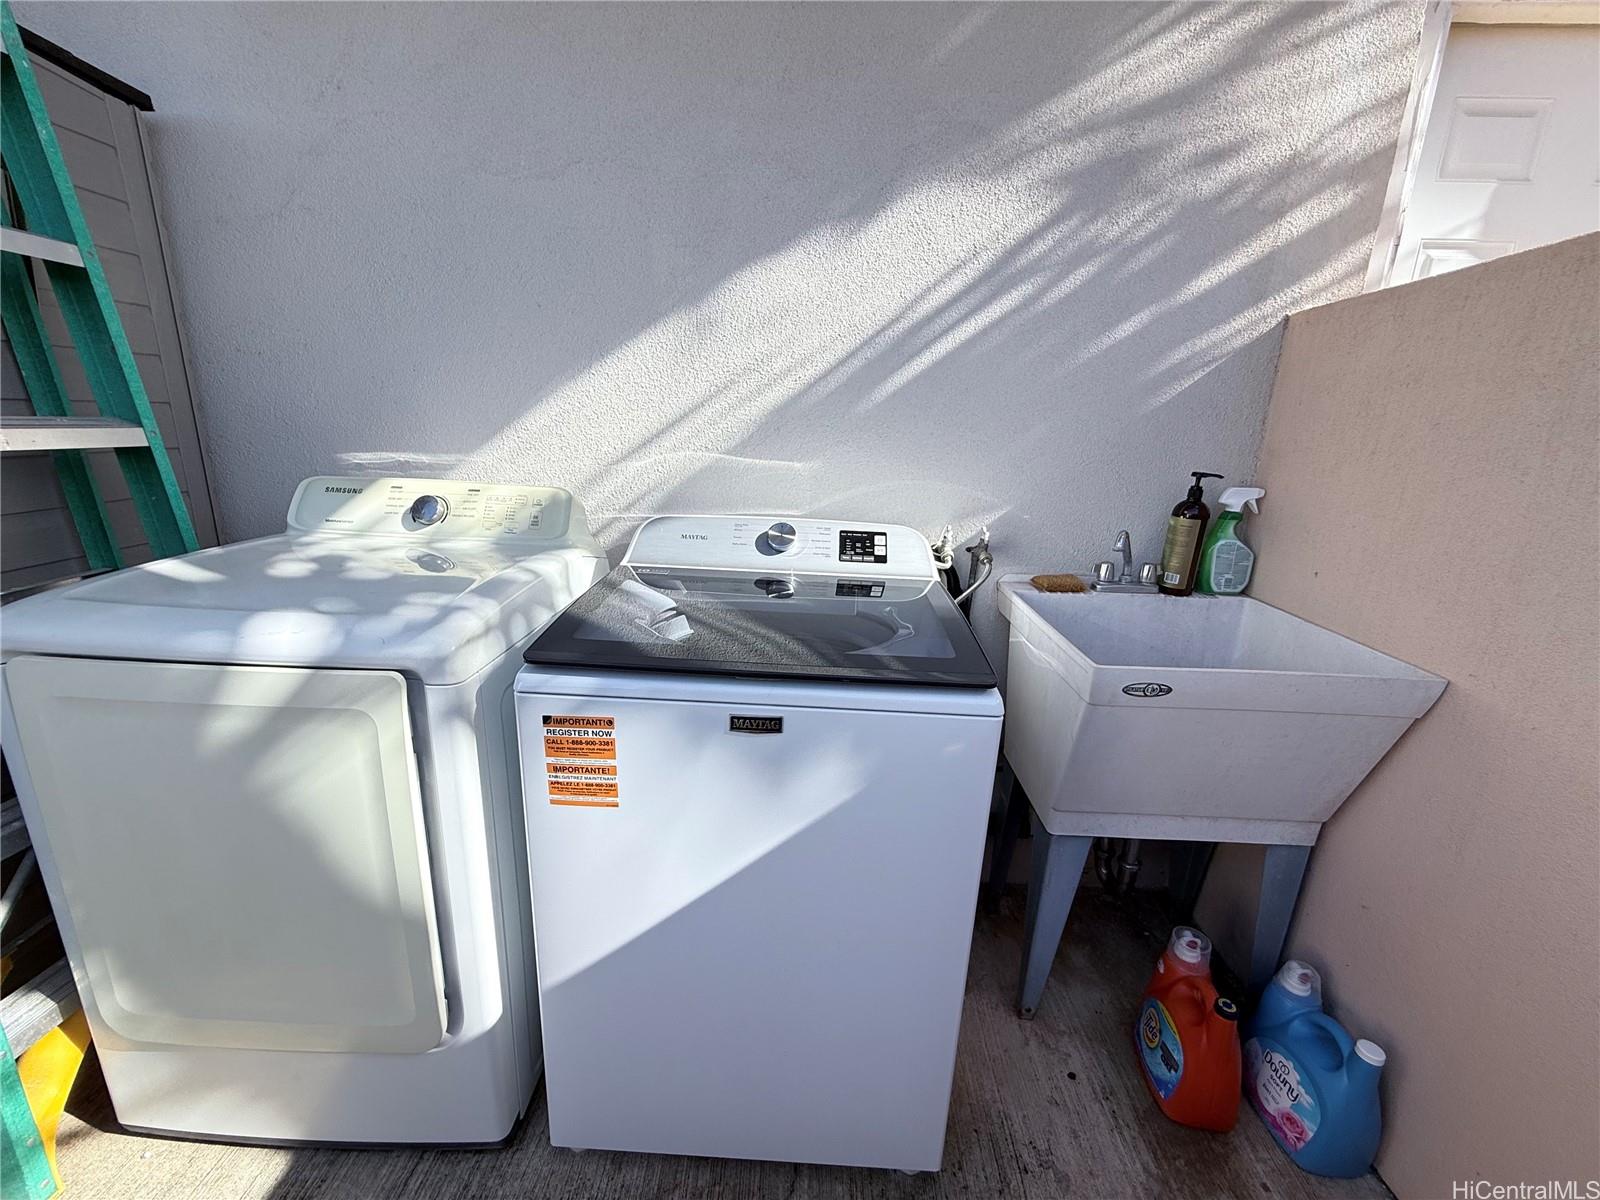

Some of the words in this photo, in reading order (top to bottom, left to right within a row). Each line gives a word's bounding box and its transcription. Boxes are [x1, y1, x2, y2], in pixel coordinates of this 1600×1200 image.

[325, 486, 364, 494] SAMSUNG
[552, 718, 606, 727] IMPORTANT!
[732, 718, 780, 730] MAYTAG
[546, 728, 589, 737] REGISTER
[552, 765, 610, 775] IMPORTANTE!
[1143, 1013, 1159, 1041] Tide
[1264, 1050, 1299, 1102] Downy
